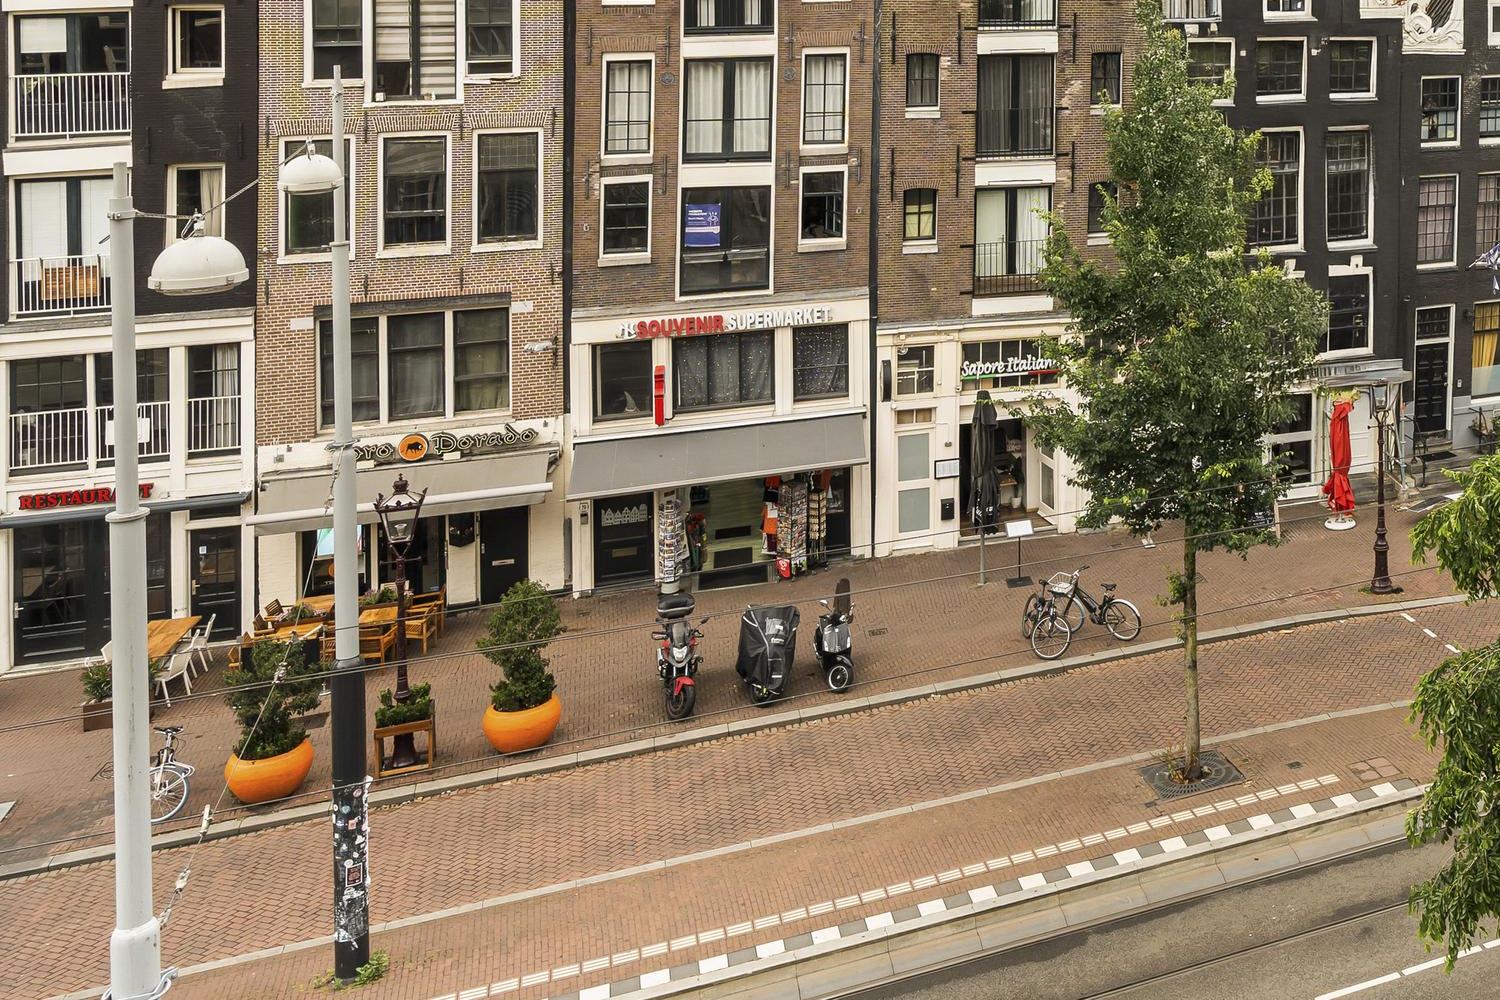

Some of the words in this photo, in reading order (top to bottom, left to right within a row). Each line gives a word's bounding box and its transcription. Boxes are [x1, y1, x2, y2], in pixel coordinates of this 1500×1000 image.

[636, 314, 725, 339] SOUVENIR
[727, 306, 833, 331] SUPERMARKET
[961, 360, 1005, 379] Sapore
[1006, 354, 1061, 373] Italian
[430, 422, 539, 455] Dorado
[19, 482, 155, 511] RESTAURT
